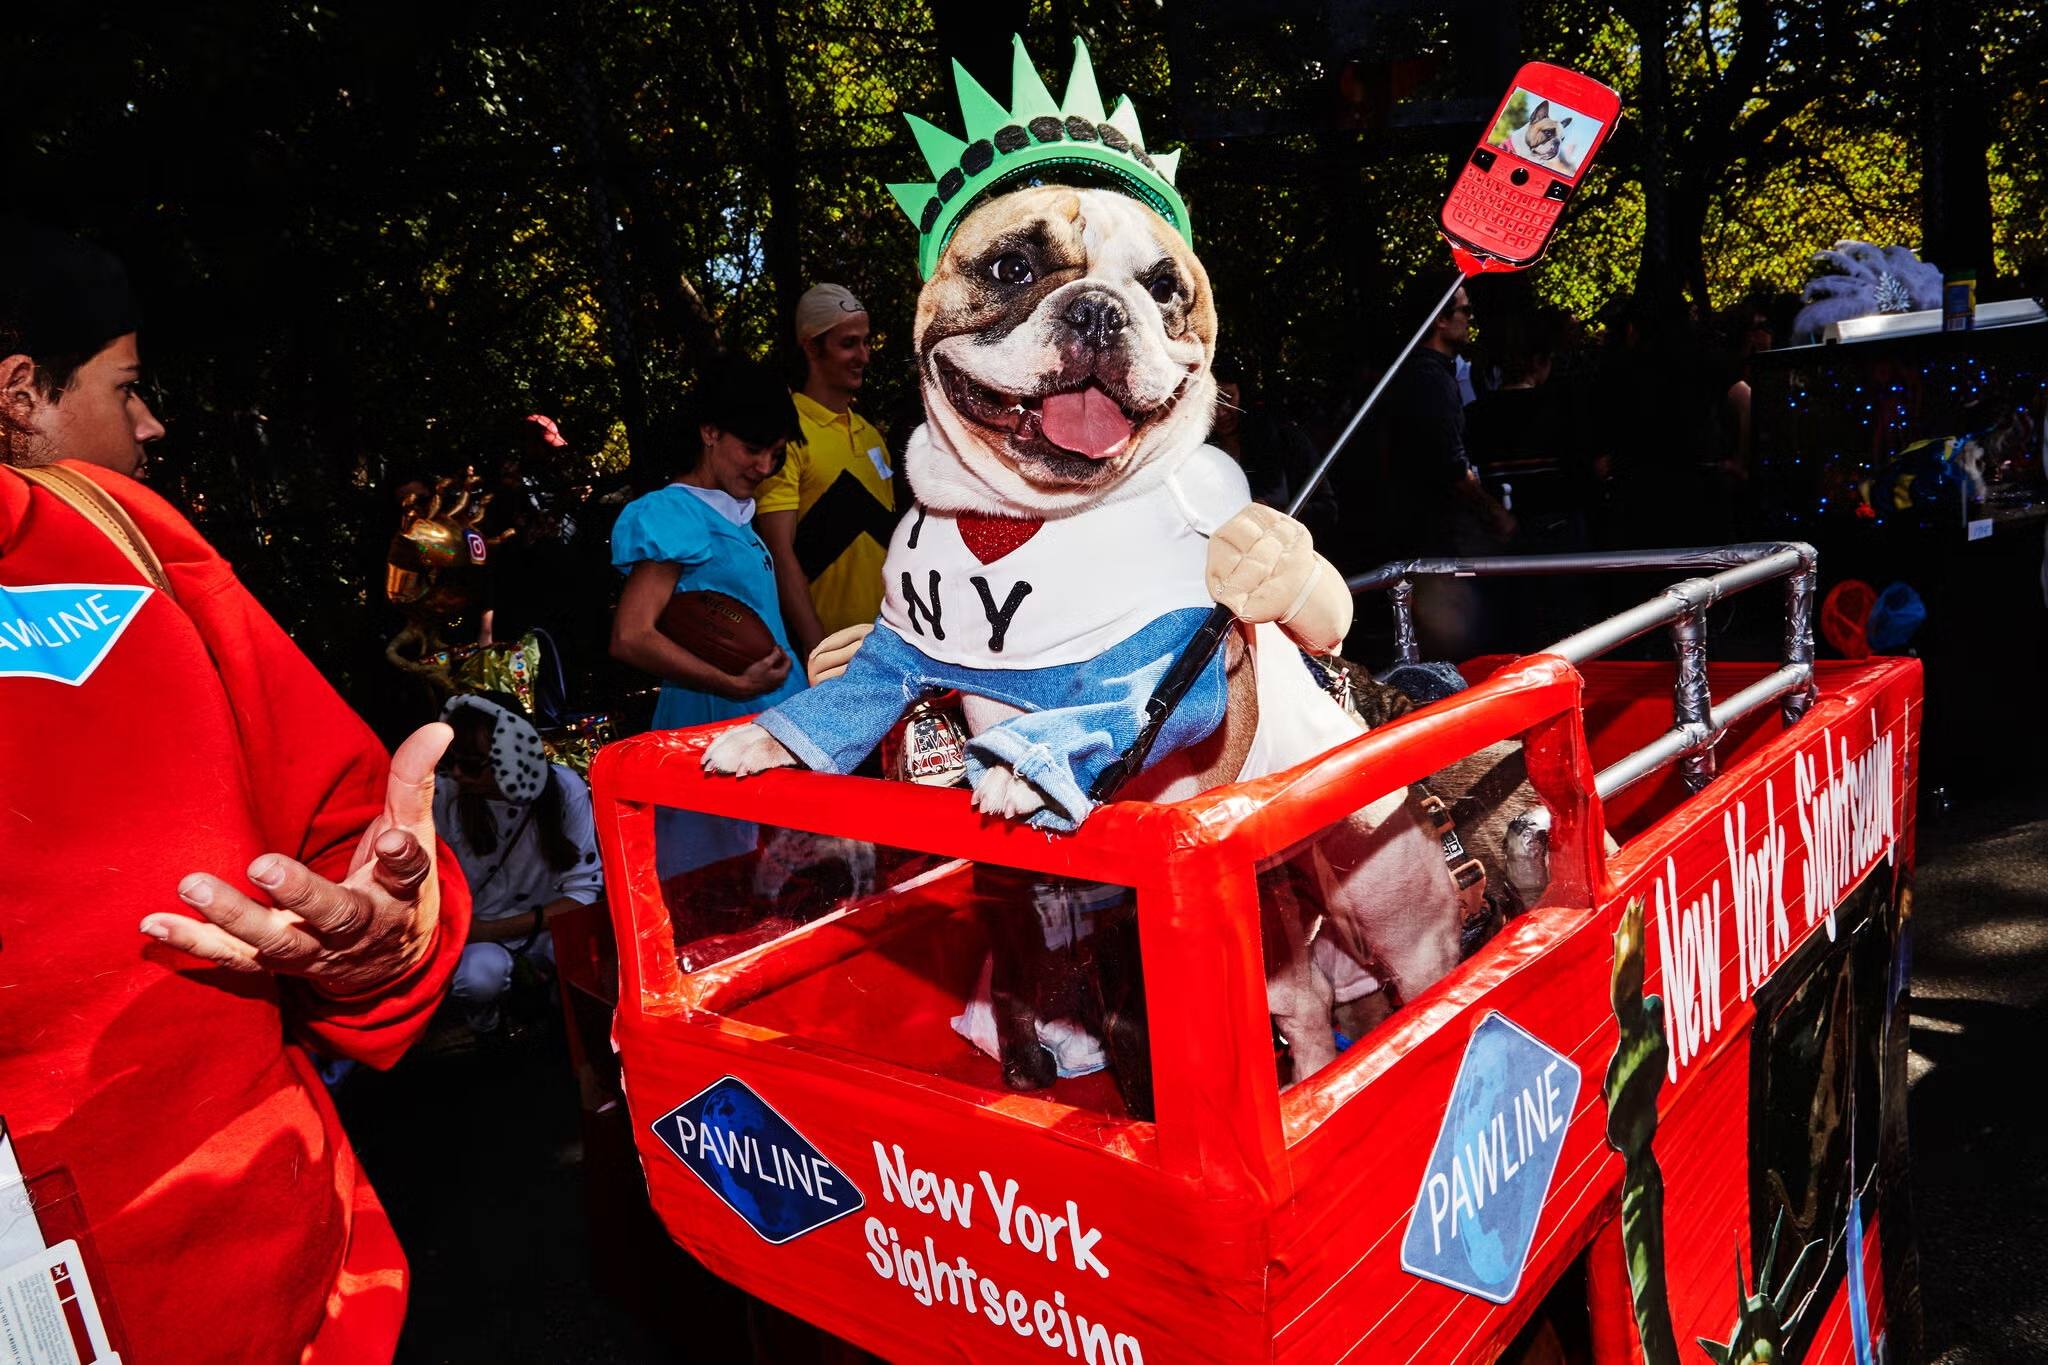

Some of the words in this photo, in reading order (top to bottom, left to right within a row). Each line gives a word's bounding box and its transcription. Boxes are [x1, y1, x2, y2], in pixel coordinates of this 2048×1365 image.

[1655, 856, 1721, 1084] New
[1724, 779, 1790, 1002] York
[675, 1115, 838, 1206] PAWLINE
[872, 1140, 974, 1229] New
[979, 1170, 1109, 1279] York
[1428, 1060, 1563, 1256] PAWLINE
